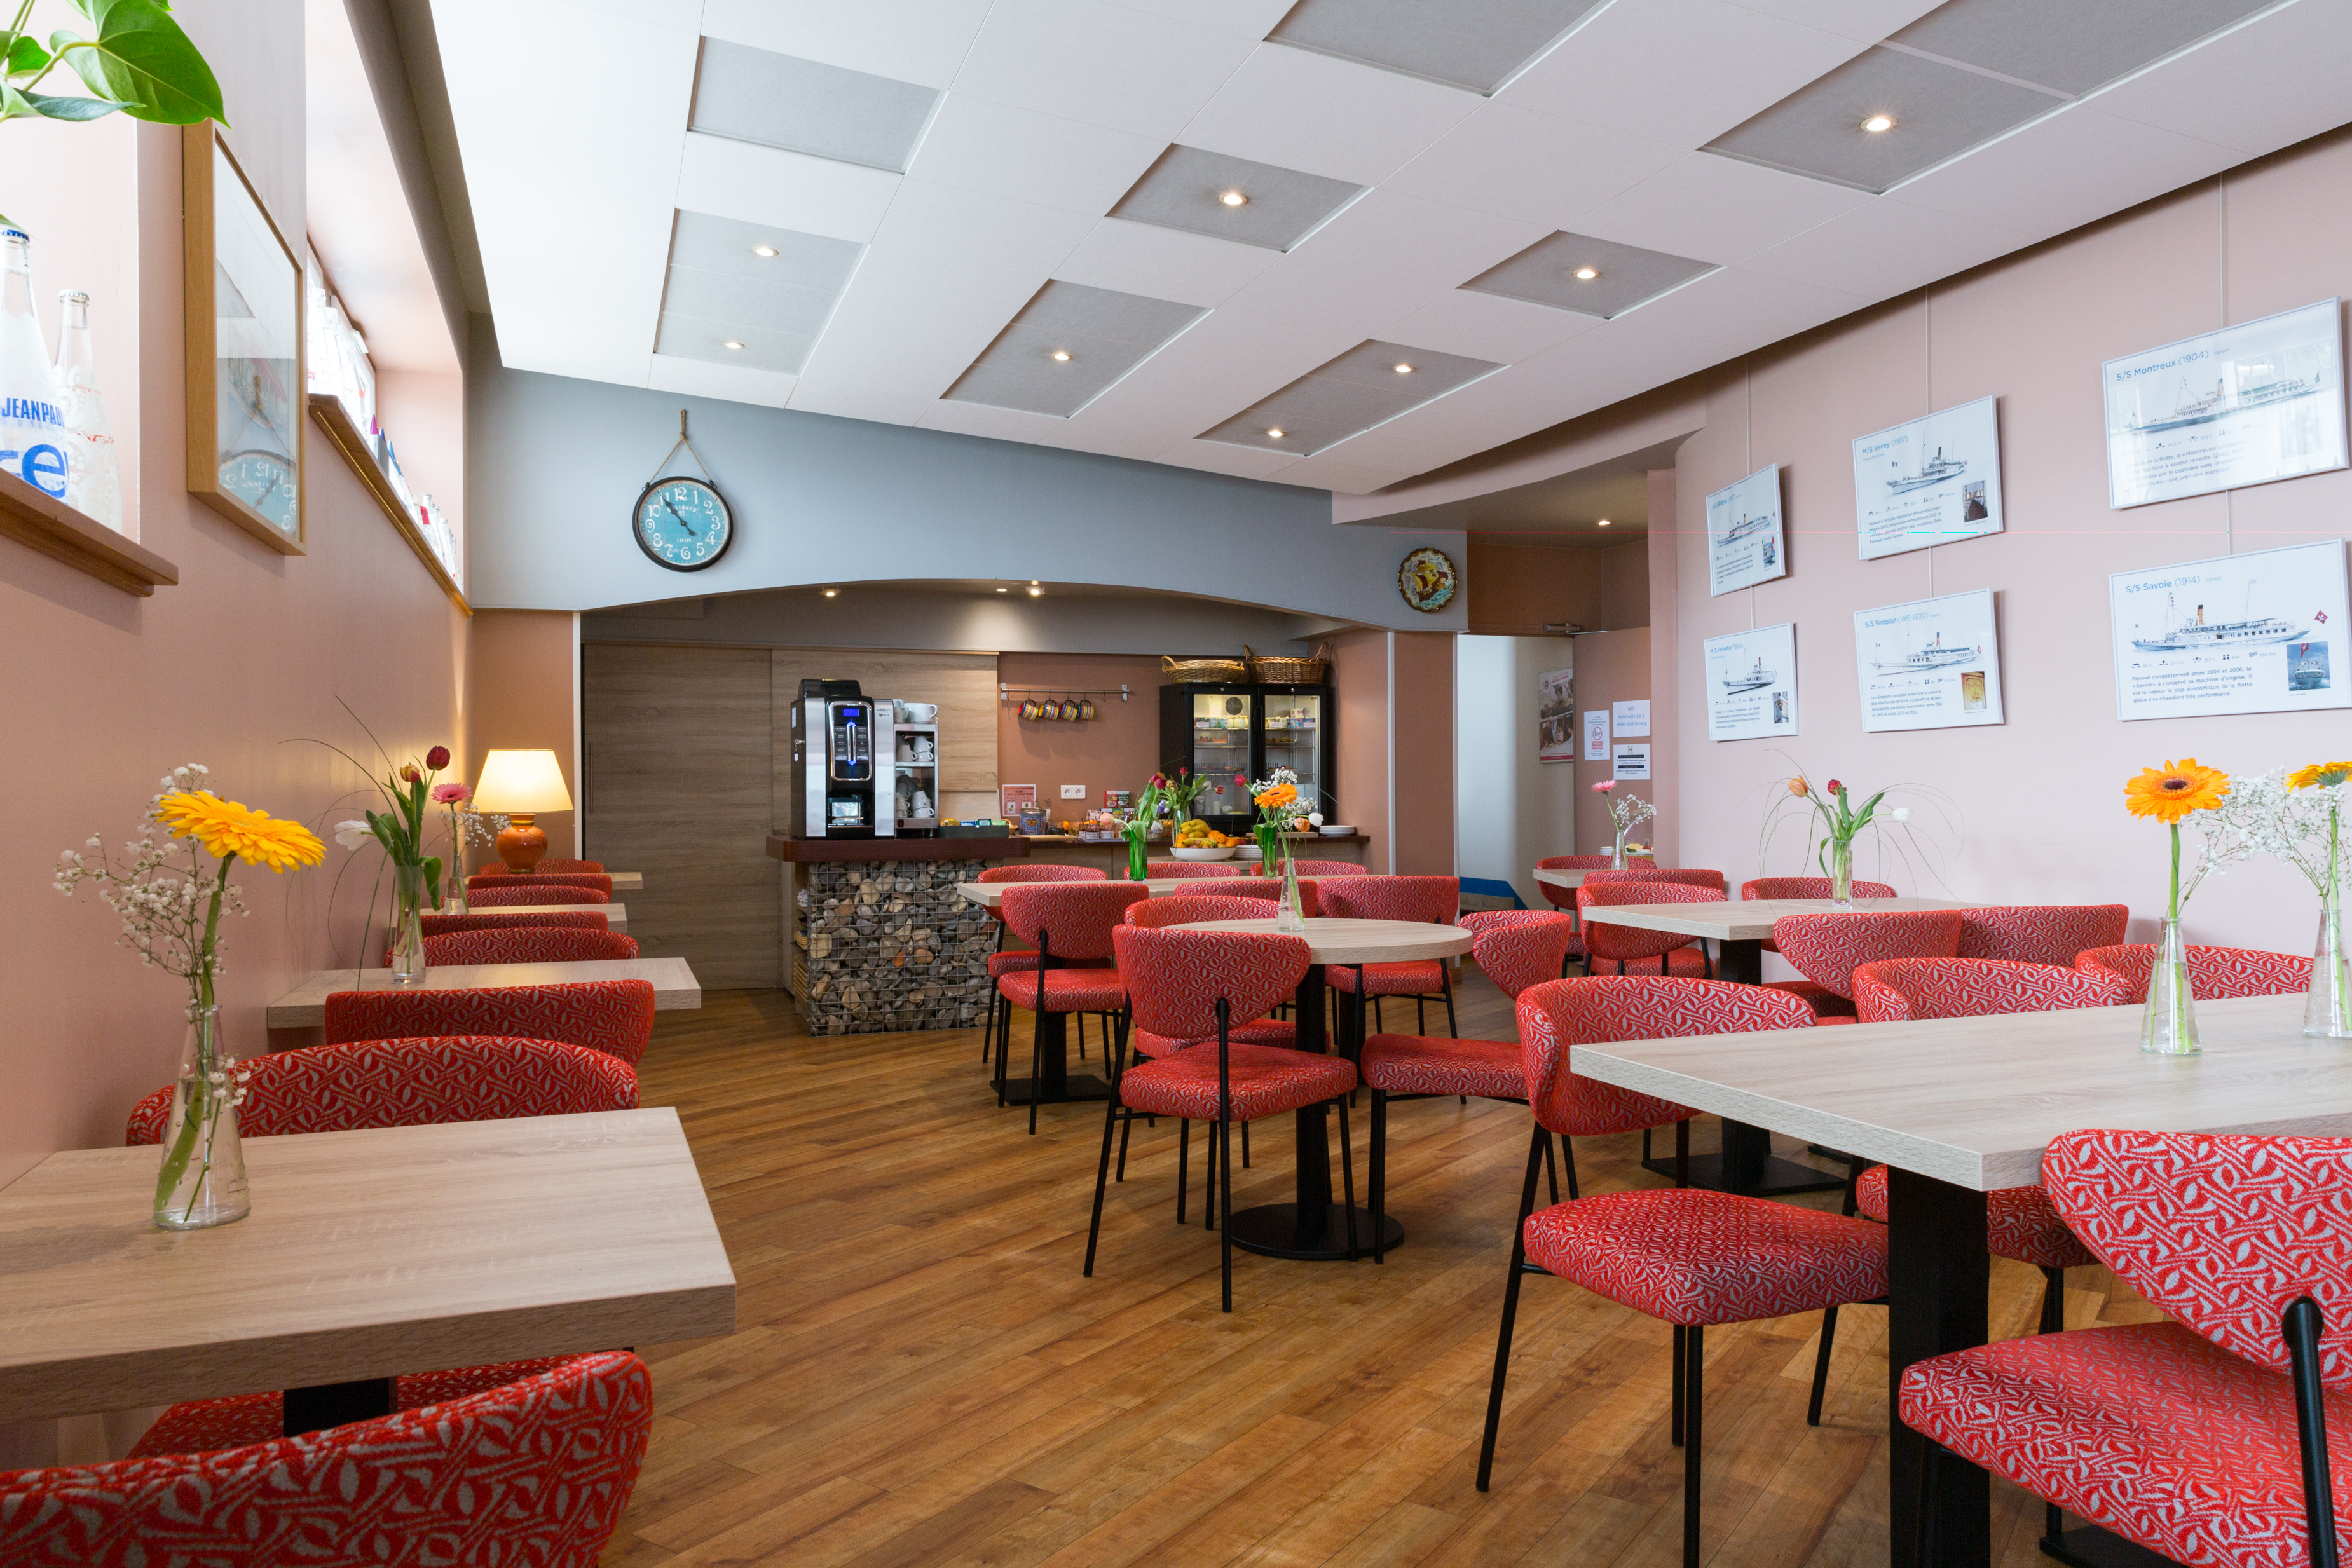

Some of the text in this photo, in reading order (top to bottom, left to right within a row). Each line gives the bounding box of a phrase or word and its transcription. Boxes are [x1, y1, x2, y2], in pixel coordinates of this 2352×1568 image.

[2117, 371, 2131, 381] S/S
[2134, 360, 2176, 376] Montreux
[2178, 351, 2209, 365] (1904)
[1862, 436, 1908, 454] M/S Vevey (1907)
[2142, 465, 2163, 473] machine
[2180, 472, 2203, 481] première
[659, 492, 669, 505] 11
[673, 487, 687, 501] 12
[693, 490, 698, 504] 1
[648, 505, 660, 517] 10
[704, 500, 713, 514] 2
[645, 519, 655, 533] 9
[711, 516, 720, 530] 3
[653, 533, 662, 547] 8
[705, 531, 717, 545] 4
[665, 544, 673, 557] 7
[681, 547, 691, 560] 6
[696, 543, 704, 556] 5
[2126, 584, 2140, 593] S/S
[2143, 580, 2171, 590] Savoie
[2175, 576, 2200, 587] (1914)
[1875, 618, 1896, 626] Simplon
[1897, 612, 1928, 623] (1915-1920)
[2152, 672, 2189, 680] complètement
